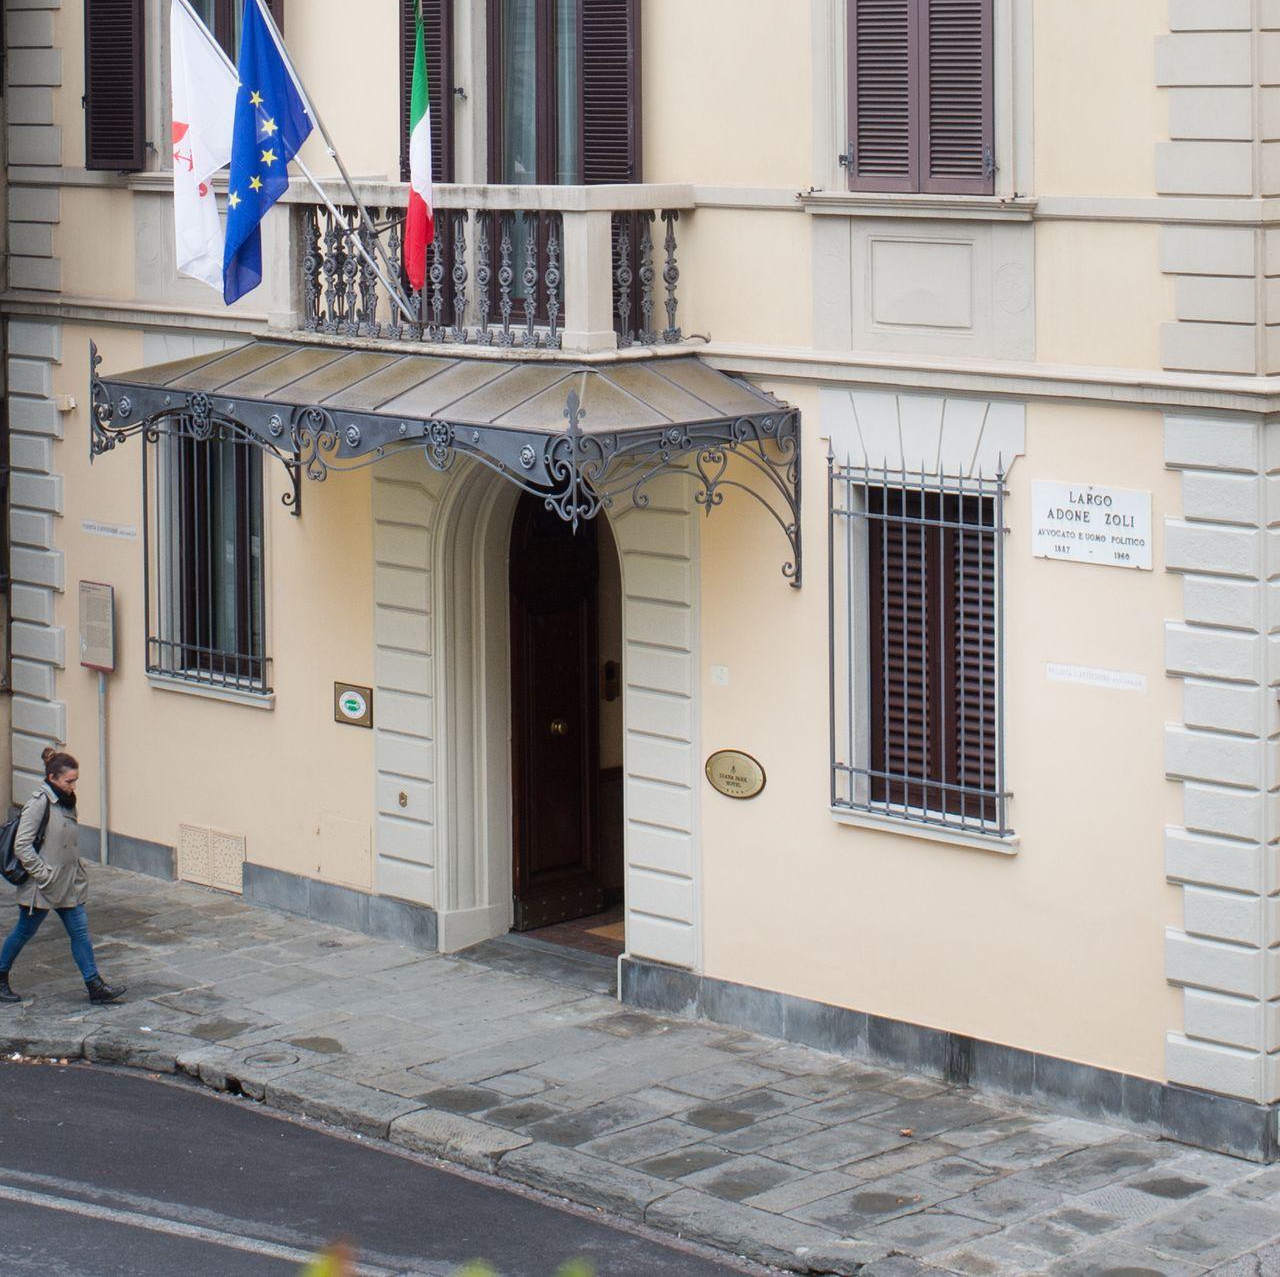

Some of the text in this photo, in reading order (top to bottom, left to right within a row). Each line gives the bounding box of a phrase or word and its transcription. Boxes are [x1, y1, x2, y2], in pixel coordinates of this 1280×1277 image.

[1069, 491, 1113, 507] LARGO
[1047, 508, 1134, 527] ADONE ZOLI
[1037, 528, 1145, 546] AVVOCATO E UOMO POLITICO
